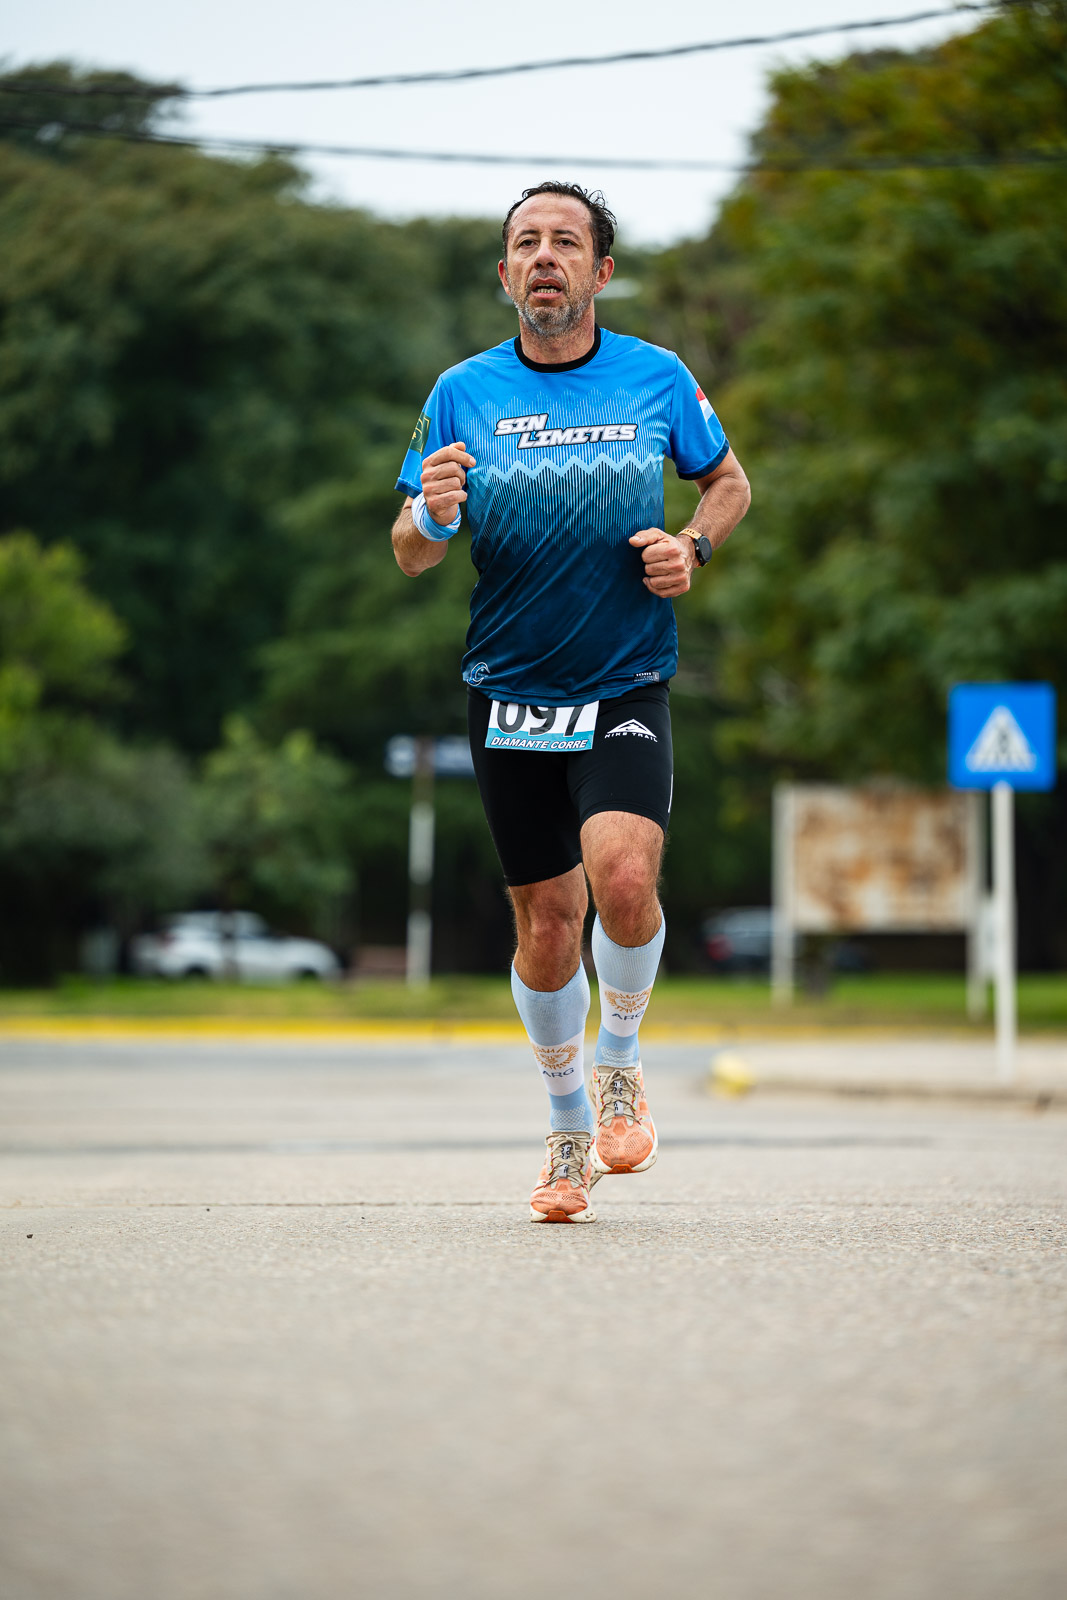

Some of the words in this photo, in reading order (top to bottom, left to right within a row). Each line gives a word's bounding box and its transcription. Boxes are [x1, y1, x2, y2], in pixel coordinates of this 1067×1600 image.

[494, 413, 548, 436] SIN
[517, 423, 638, 450] LIMITES
[497, 701, 585, 737] 097
[490, 737, 550, 749] DIAMANTE
[550, 739, 588, 750] CORRE
[631, 732, 658, 743] TRAIL
[542, 1067, 575, 1078] ARG
